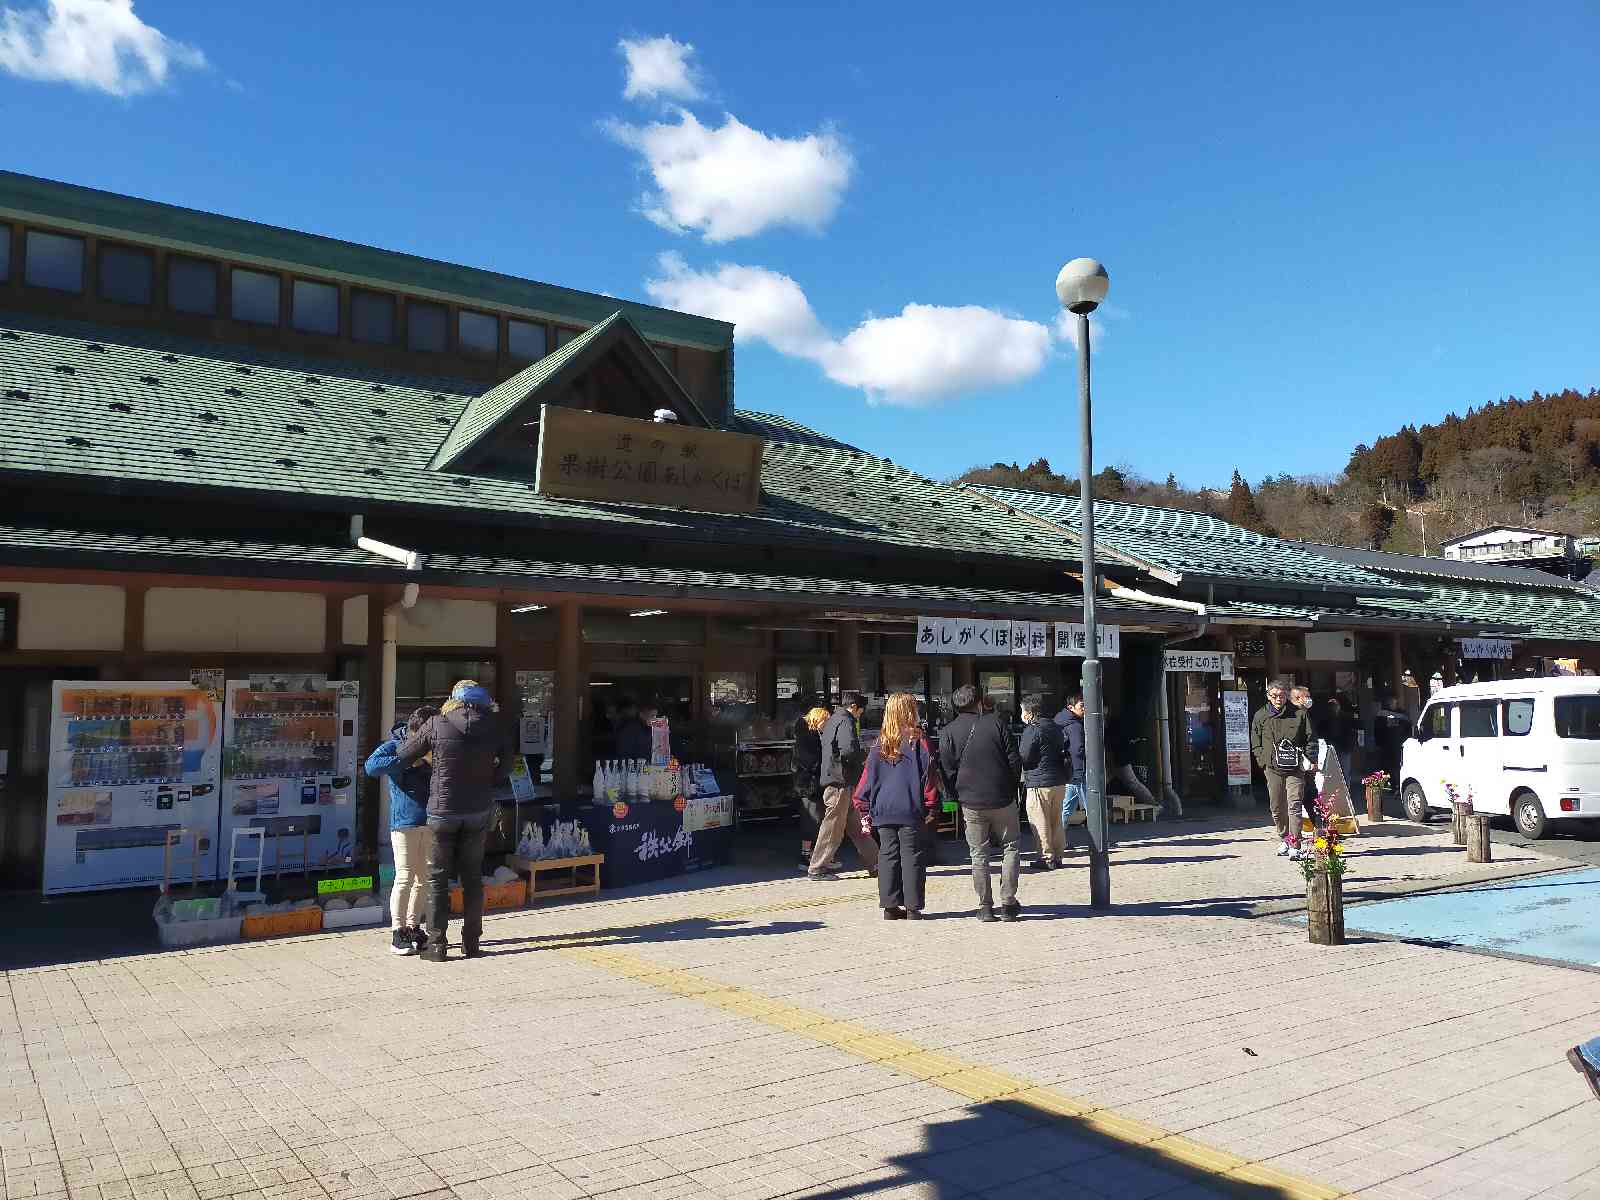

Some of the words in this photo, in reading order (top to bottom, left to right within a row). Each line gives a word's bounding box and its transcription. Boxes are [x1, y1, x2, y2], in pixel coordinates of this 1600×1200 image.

[615, 433, 699, 459] 道の駅
[559, 454, 748, 496] 果樹公園あしがくぼ
[920, 625, 1046, 649] あしがくぼ氷柱
